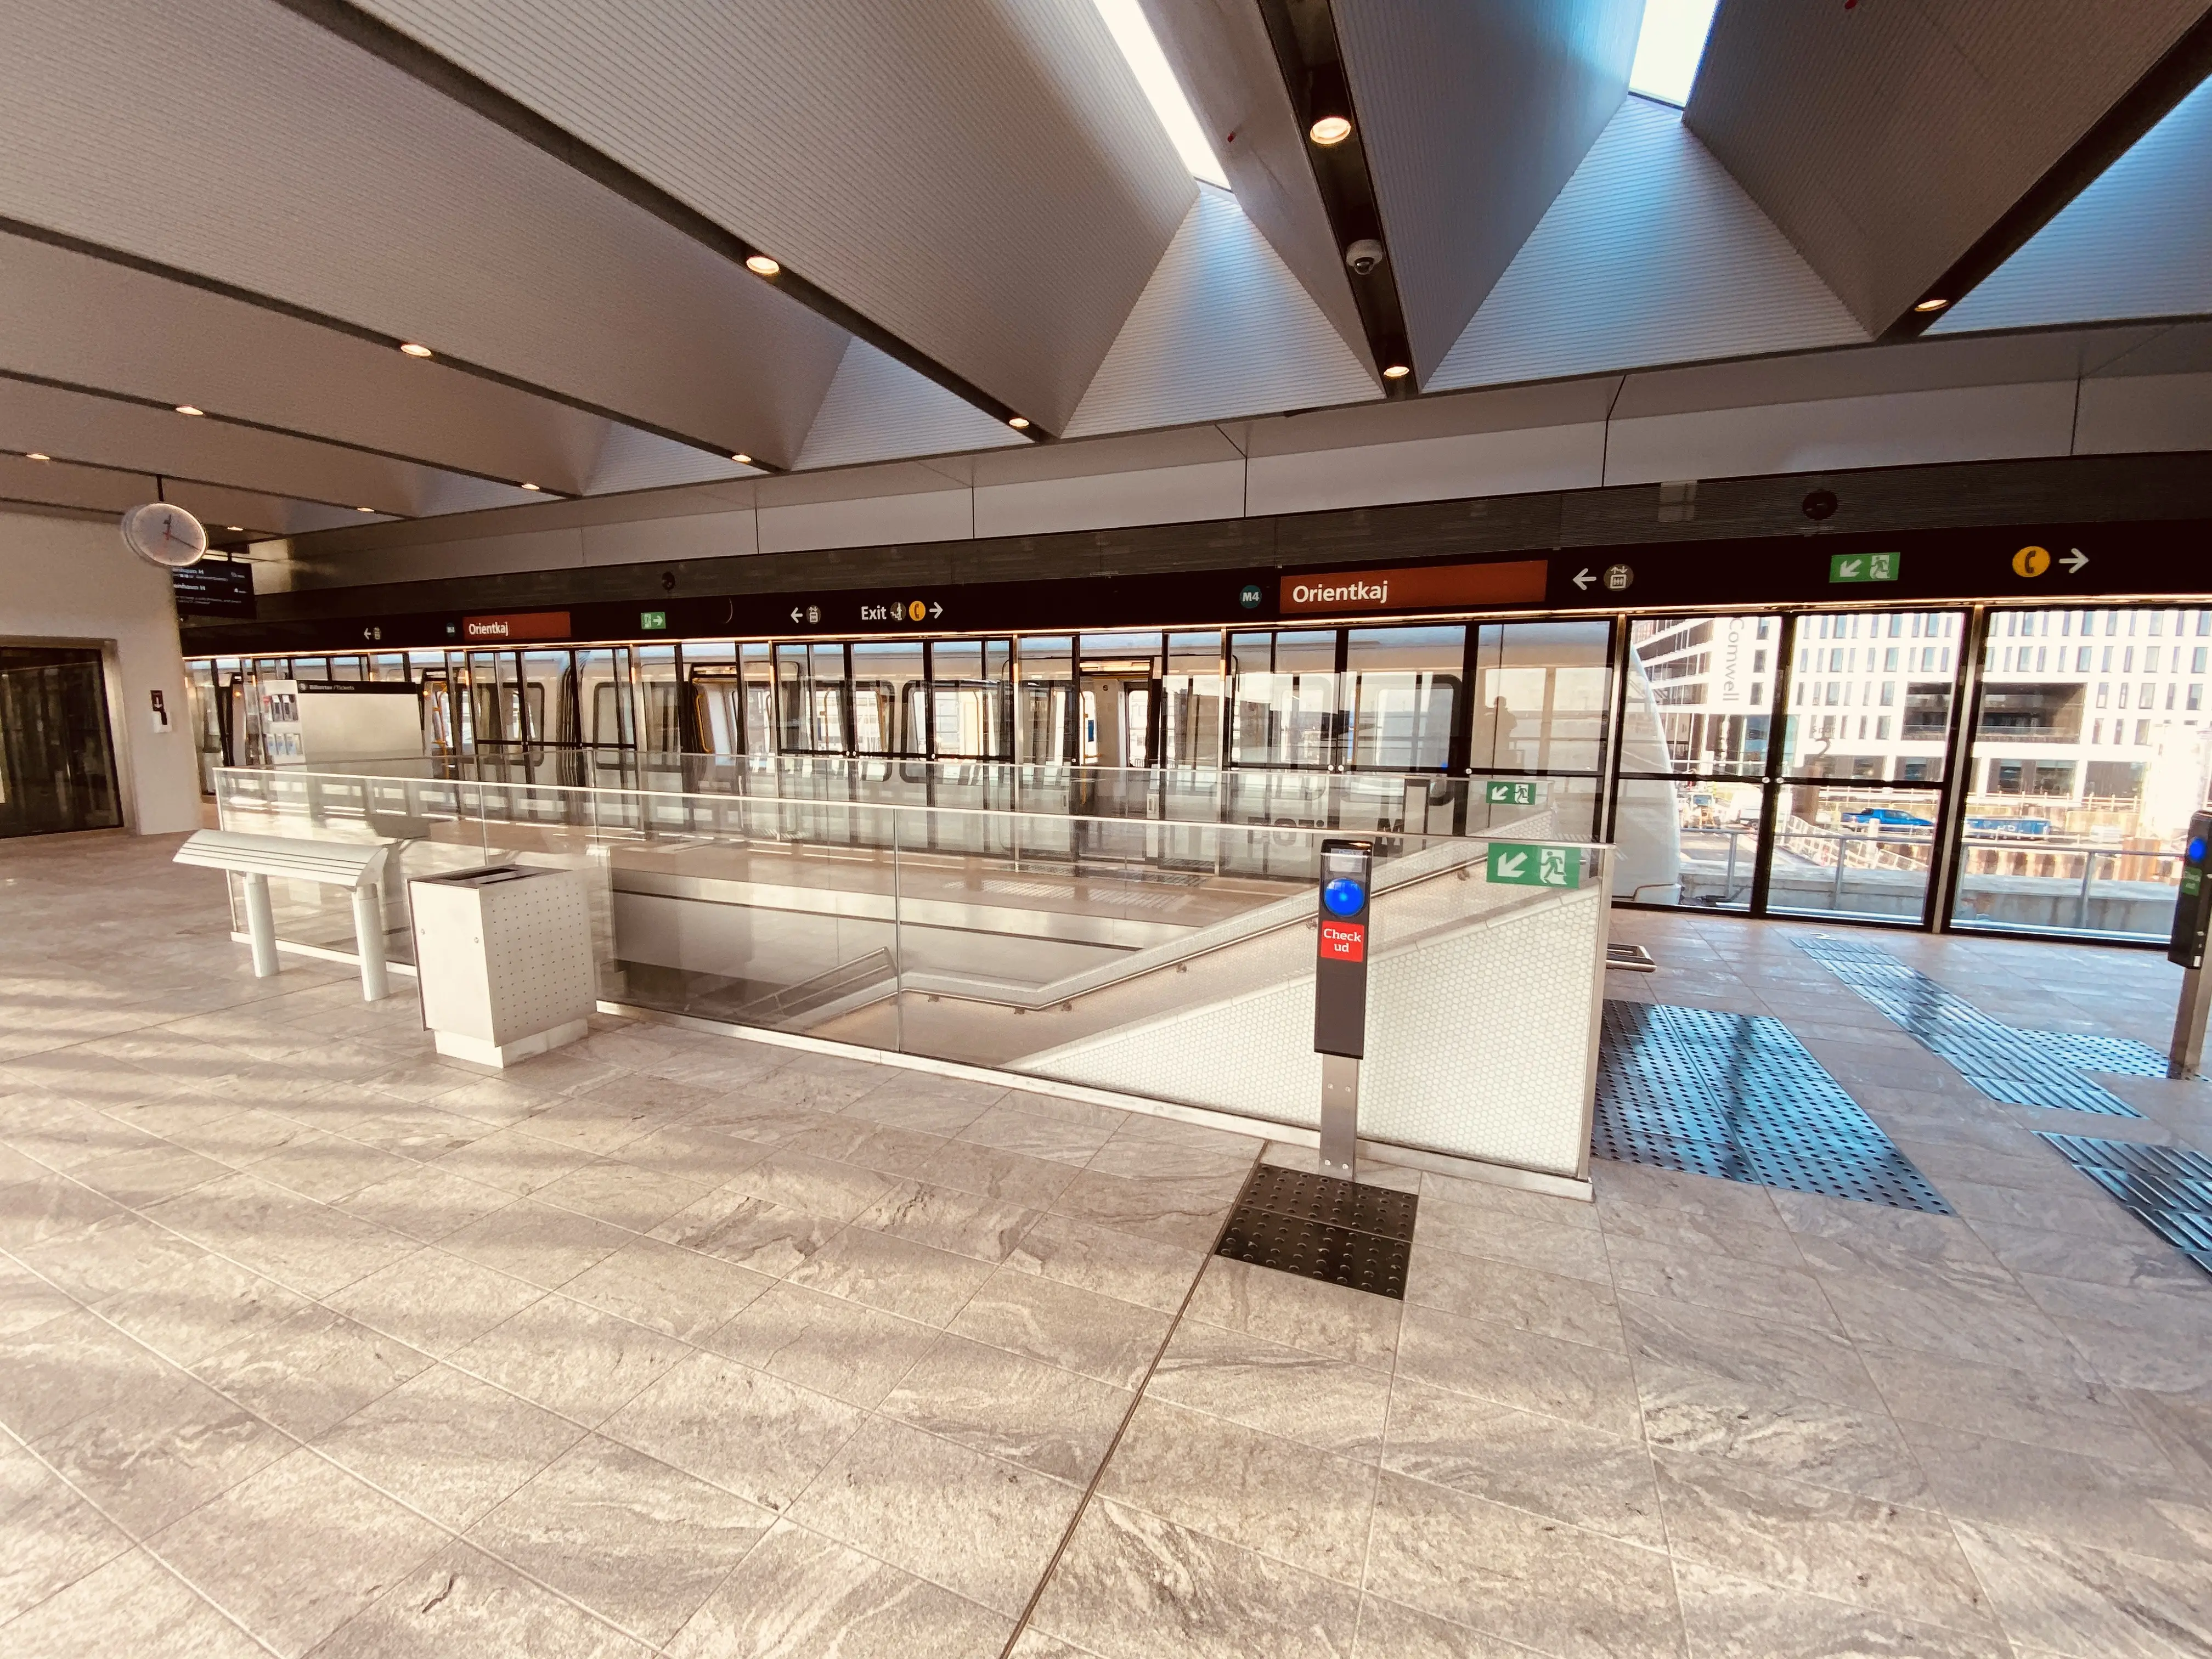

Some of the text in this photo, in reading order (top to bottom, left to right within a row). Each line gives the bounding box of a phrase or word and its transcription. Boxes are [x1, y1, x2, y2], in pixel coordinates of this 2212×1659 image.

[1243, 592, 1260, 601] M4
[1293, 580, 1388, 604] Orientkaj
[861, 605, 887, 620] Exit
[469, 622, 509, 636] Orientkaj
[1723, 618, 1745, 701] Comwell
[1323, 928, 1362, 942] Check
[1334, 943, 1350, 952] ud
